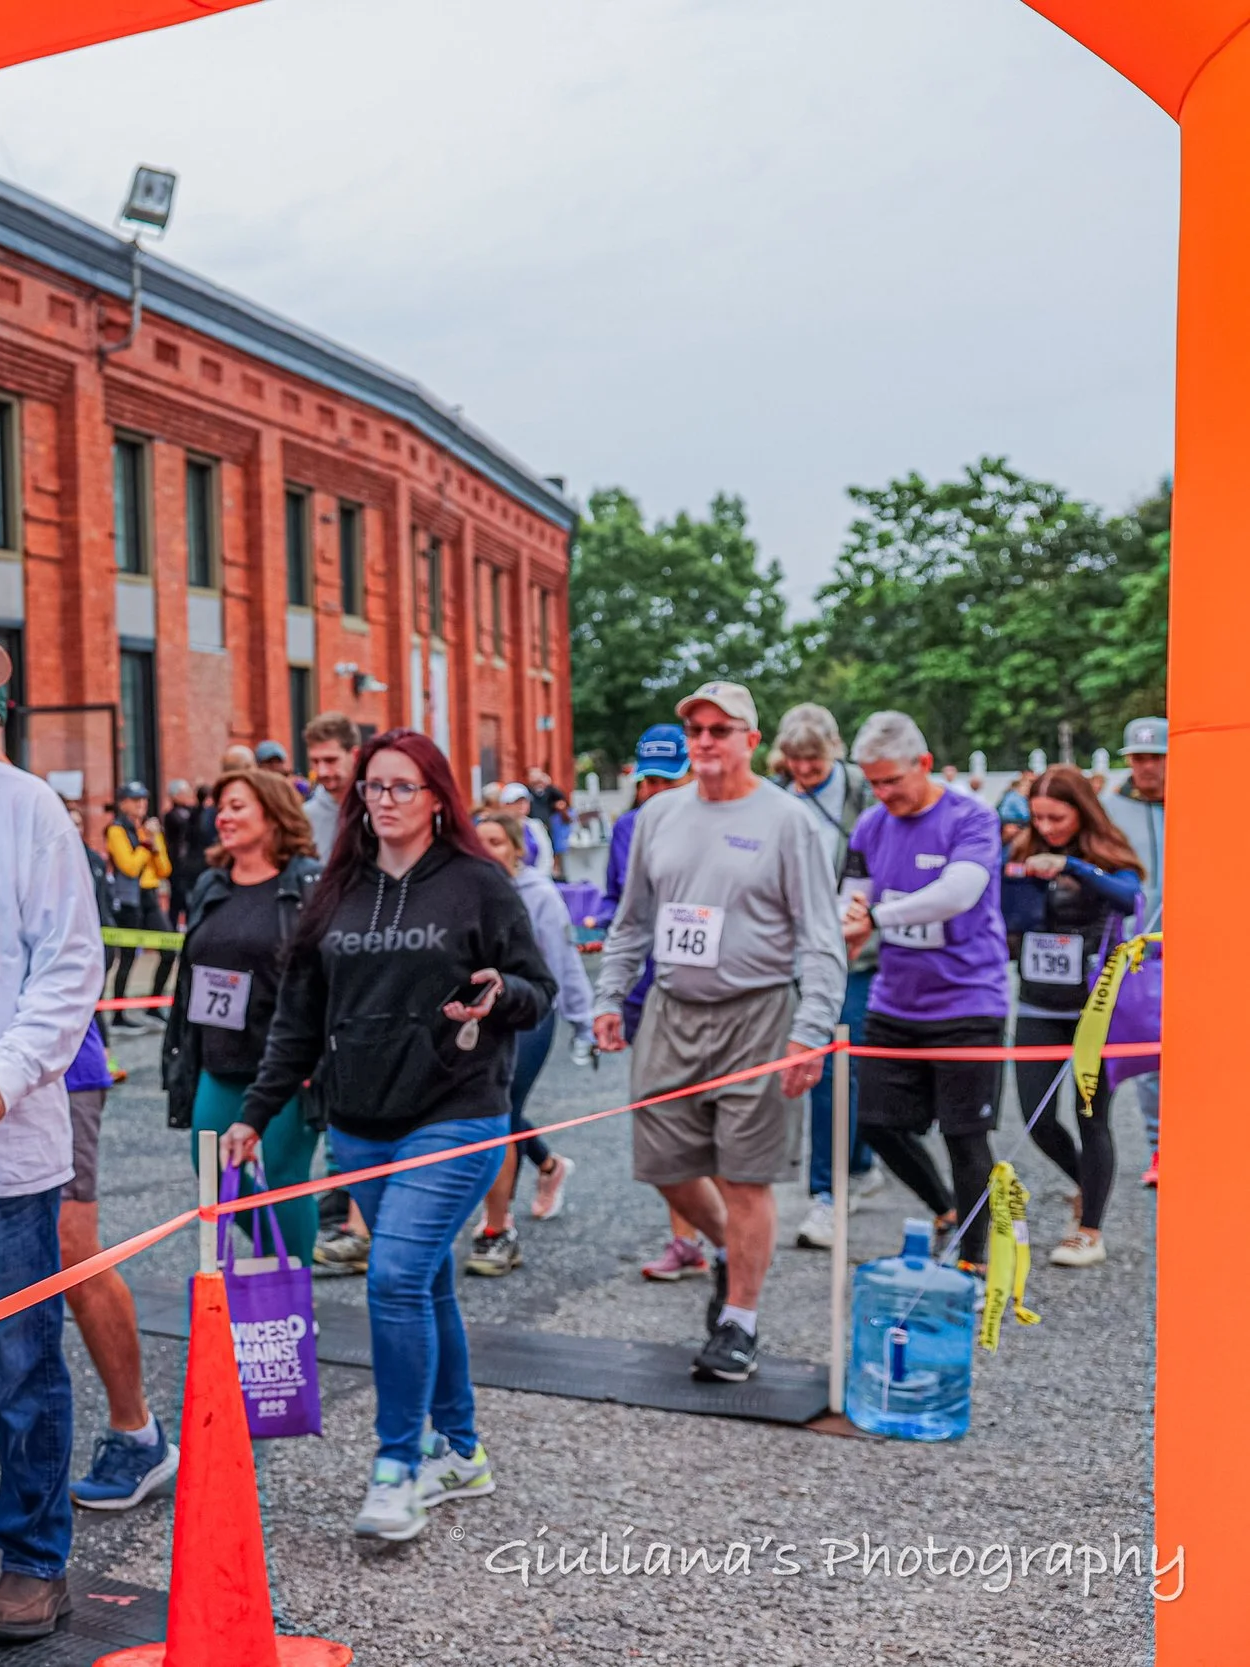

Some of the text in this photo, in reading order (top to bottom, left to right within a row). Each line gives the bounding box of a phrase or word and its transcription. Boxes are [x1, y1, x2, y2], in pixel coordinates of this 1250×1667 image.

[667, 928, 706, 956] 148
[1032, 953, 1071, 975] 139
[206, 990, 232, 1019] 73
